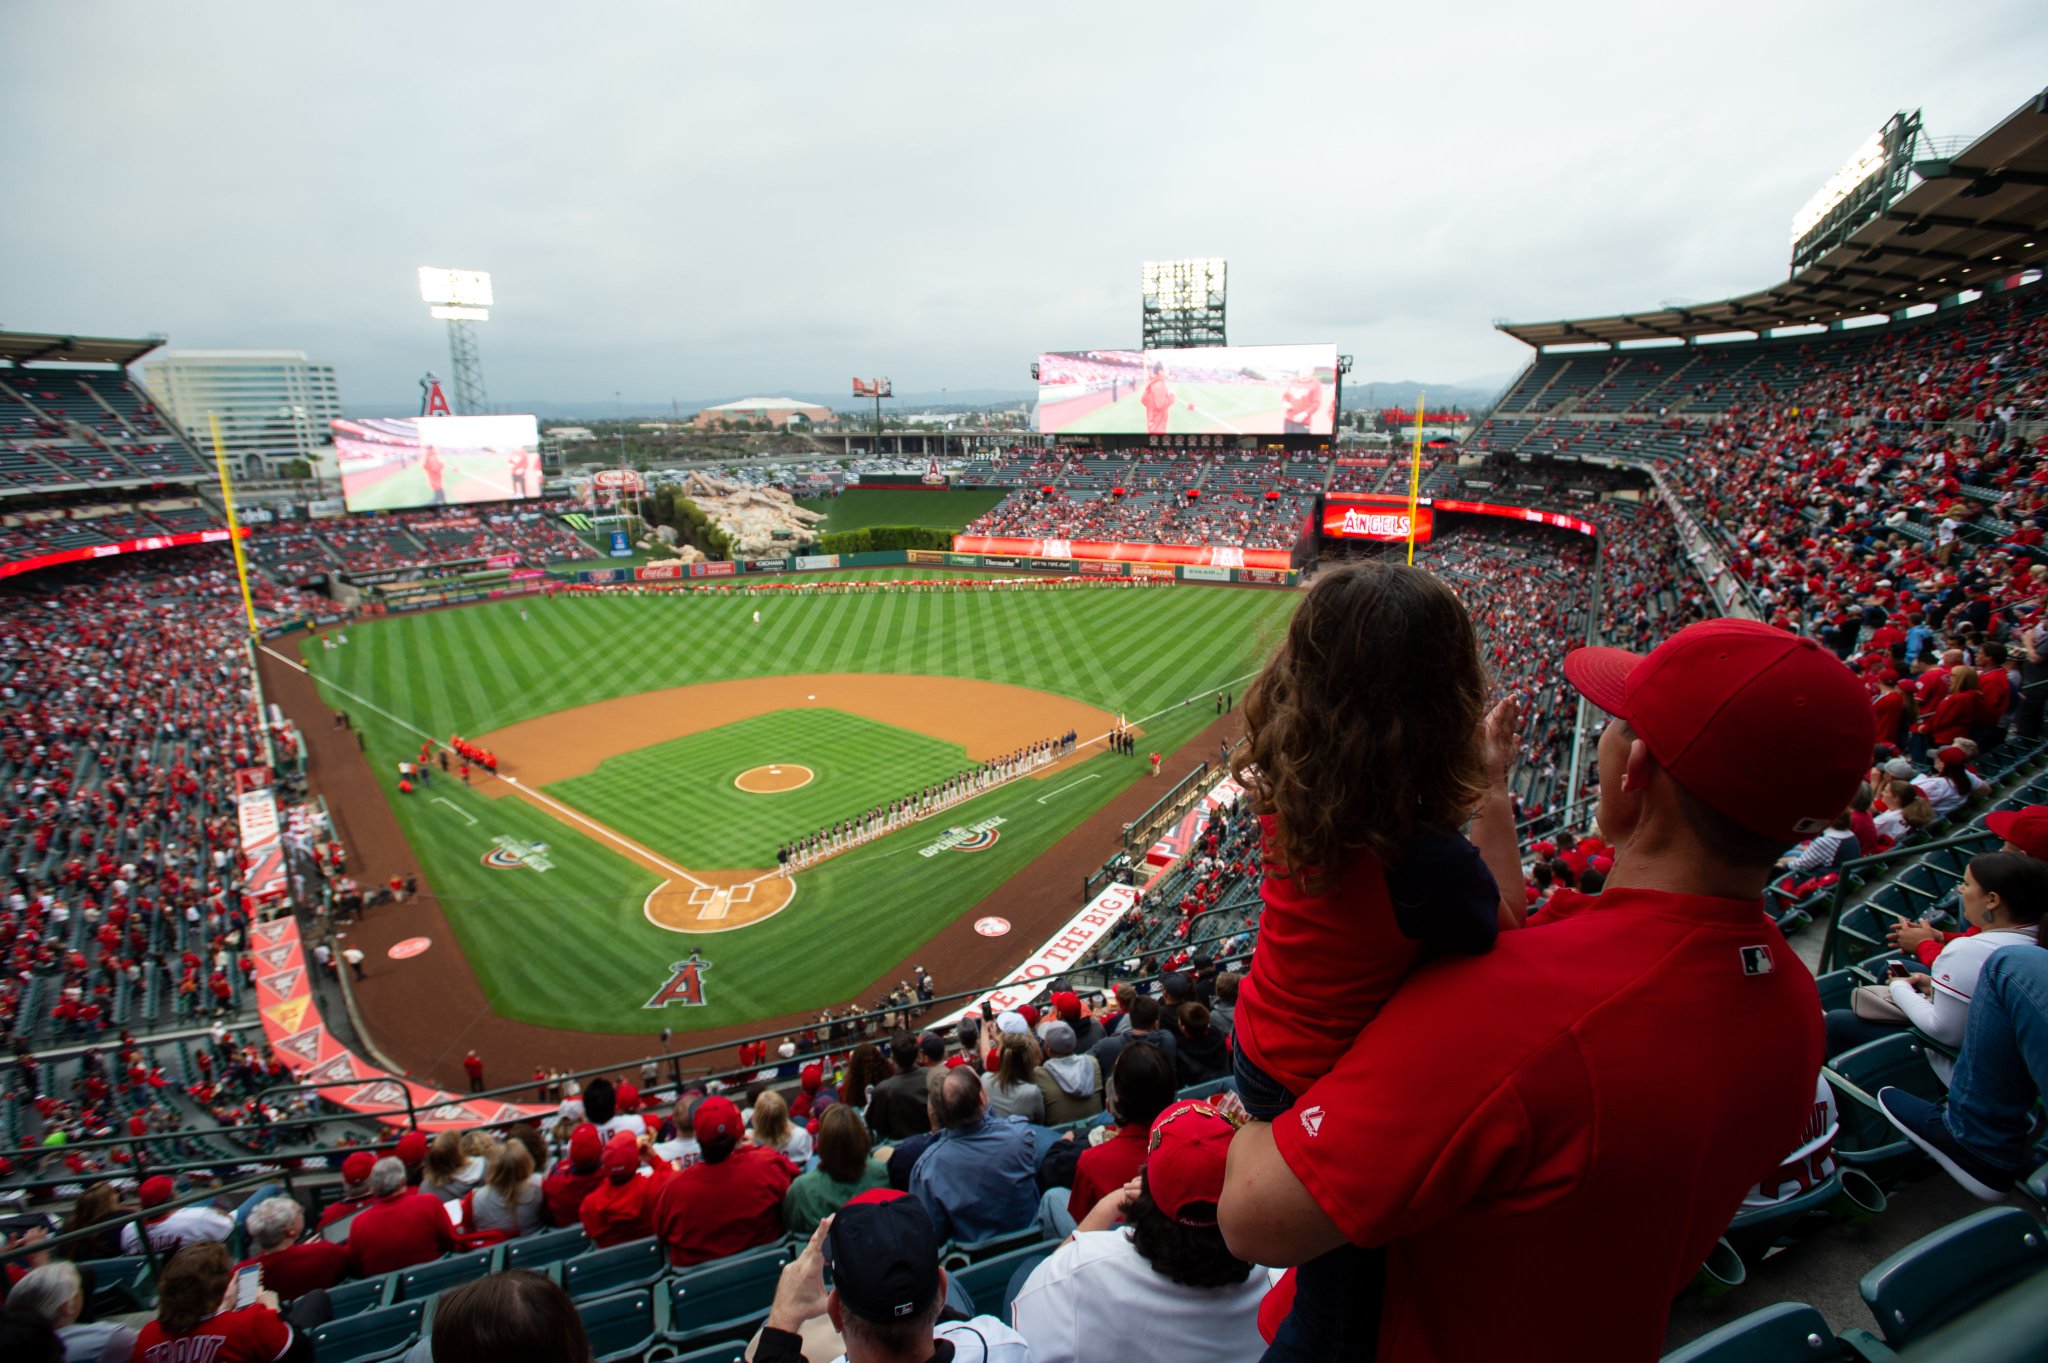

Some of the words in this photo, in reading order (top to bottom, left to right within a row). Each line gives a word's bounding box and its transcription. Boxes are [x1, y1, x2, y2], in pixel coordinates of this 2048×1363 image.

[975, 453, 994, 461] 2972
[1342, 508, 1411, 536] ANGELS
[918, 830, 976, 858] OPENING
[966, 815, 1009, 834] WEEK
[1010, 963, 1052, 991] TO
[1041, 926, 1094, 963] THE
[1081, 897, 1123, 928] BIG
[1112, 887, 1139, 899] A
[641, 953, 713, 1009] A
